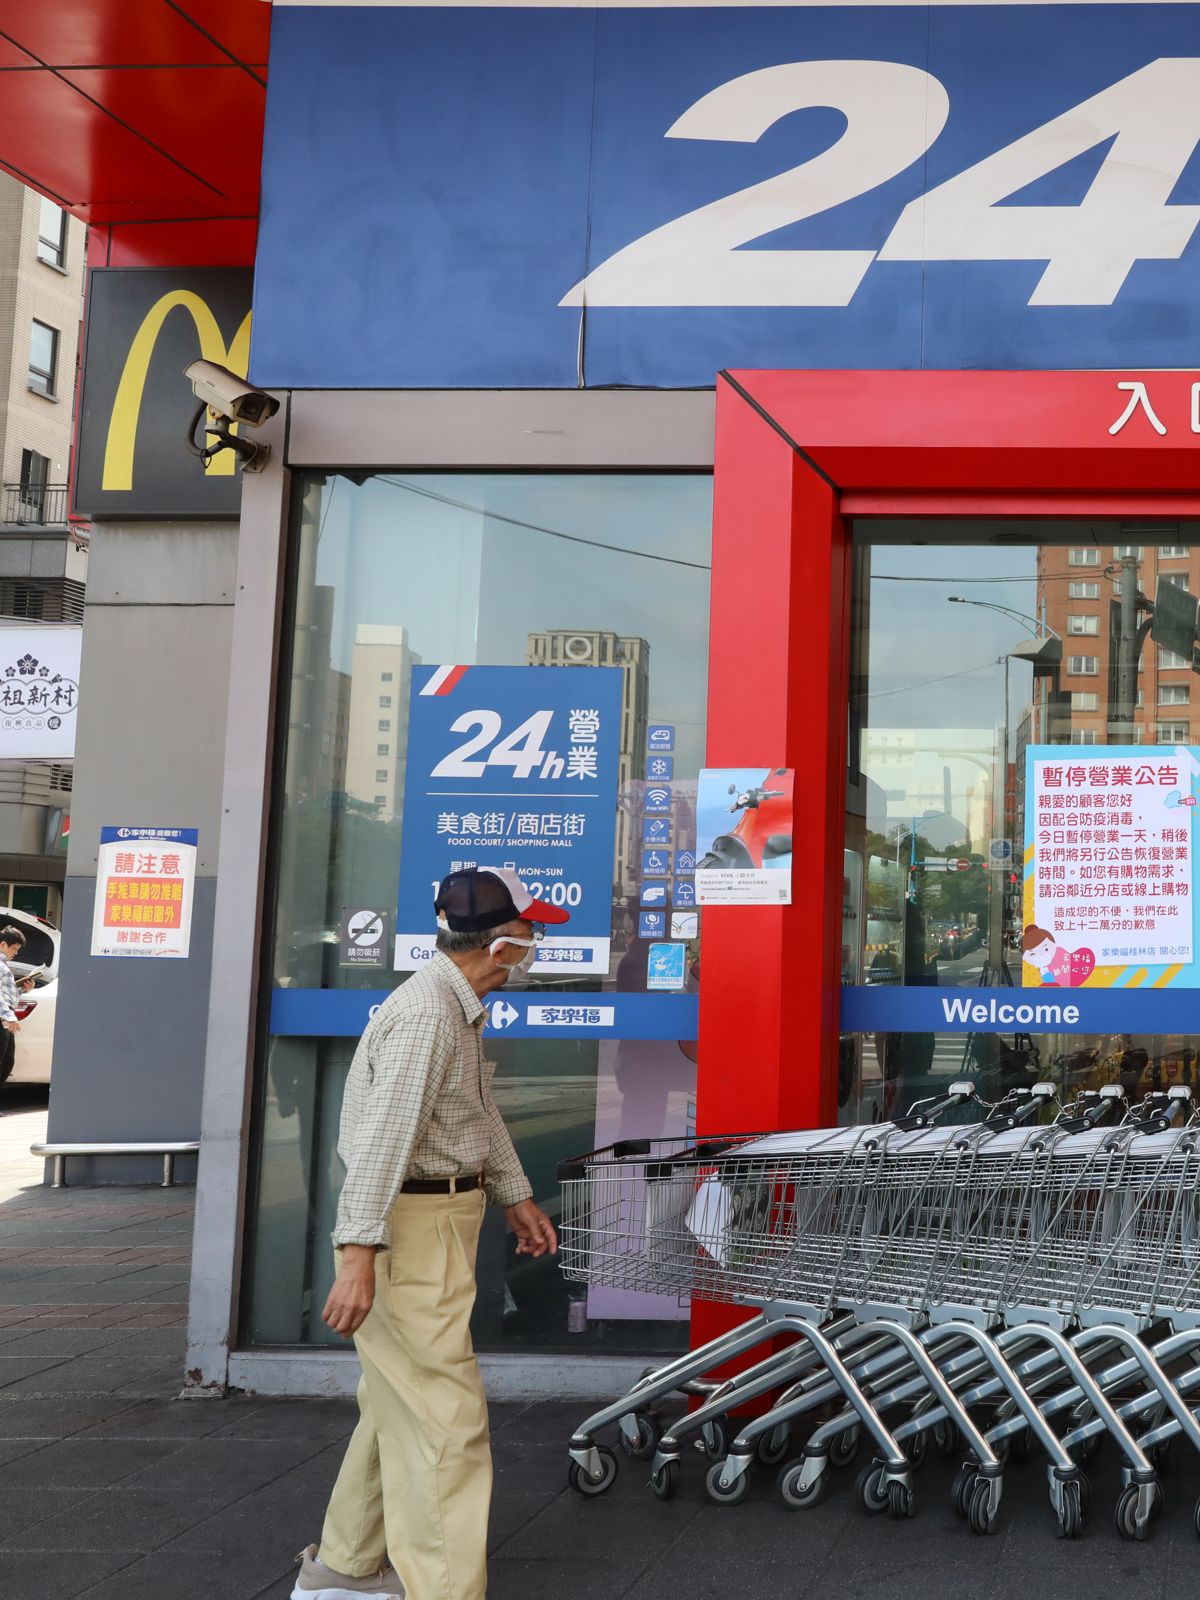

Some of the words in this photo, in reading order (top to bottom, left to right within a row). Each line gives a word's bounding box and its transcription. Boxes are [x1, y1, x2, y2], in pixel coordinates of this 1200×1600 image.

[430, 709, 565, 780] 24h
[567, 708, 600, 780] 營業
[1042, 765, 1179, 788] 暫停營業公告
[1038, 793, 1133, 809] 親愛的顧客您好
[436, 812, 586, 836] 美食街/商店街
[448, 838, 473, 846] FOOD
[506, 838, 551, 847] SHOPPING
[552, 839, 573, 847] MALL
[1039, 848, 1188, 862] 我們將另行公告恢復營業
[115, 853, 181, 875] 請注意
[518, 868, 563, 876] MON~SUN
[107, 881, 183, 902] 手推車請勿推離
[1039, 883, 1189, 899] 請洽鄰近分店或線上購物
[110, 905, 175, 923] 家樂福範圍外
[1054, 919, 1156, 932] 致上十二萬分的歉意
[116, 931, 167, 944] 謝謝合作
[538, 948, 583, 962] 家樂福
[541, 1008, 601, 1024] 家樂福
[942, 998, 1080, 1023] Welcome
